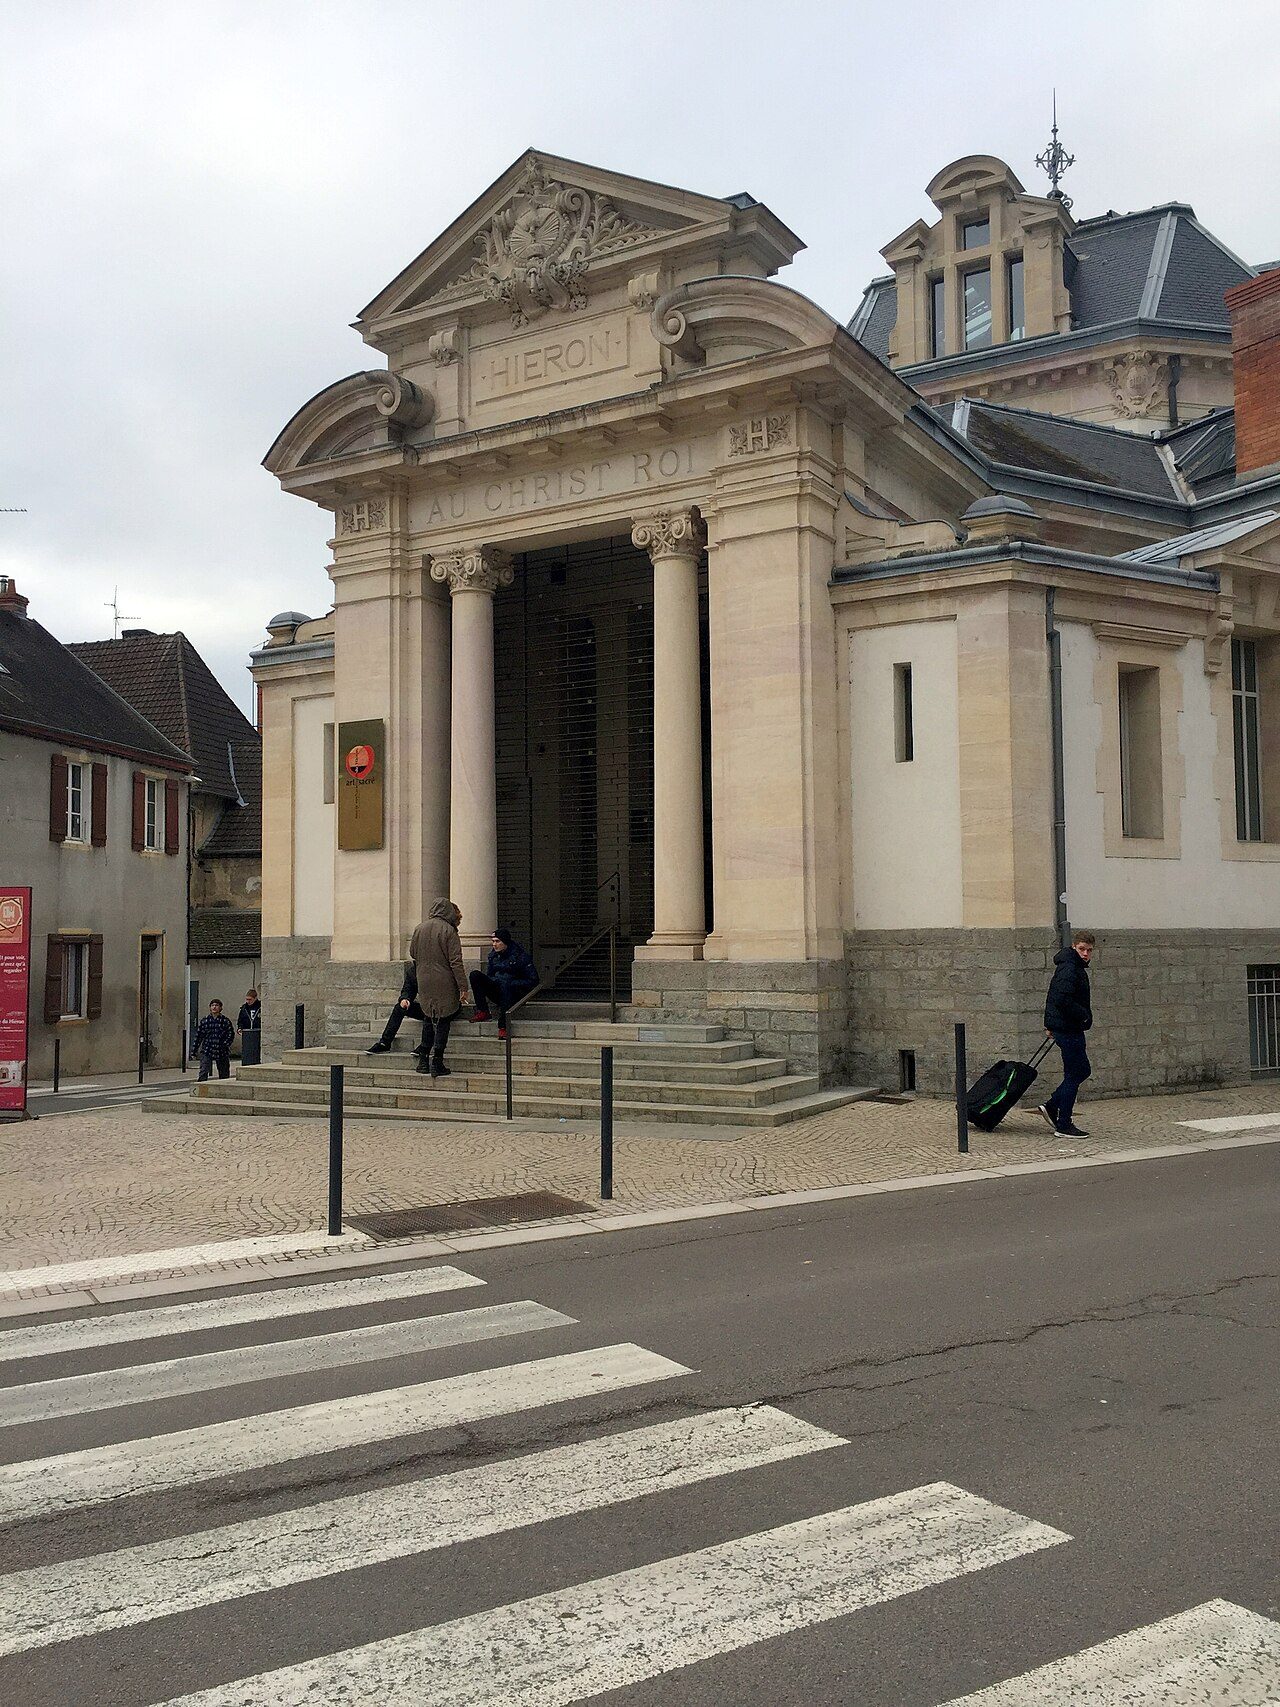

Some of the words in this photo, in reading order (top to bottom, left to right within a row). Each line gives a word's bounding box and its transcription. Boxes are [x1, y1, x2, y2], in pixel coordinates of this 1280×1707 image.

[490, 330, 611, 391] HIERON
[426, 493, 467, 525] AU
[484, 460, 611, 512] CHRIST
[632, 445, 694, 484] ROI
